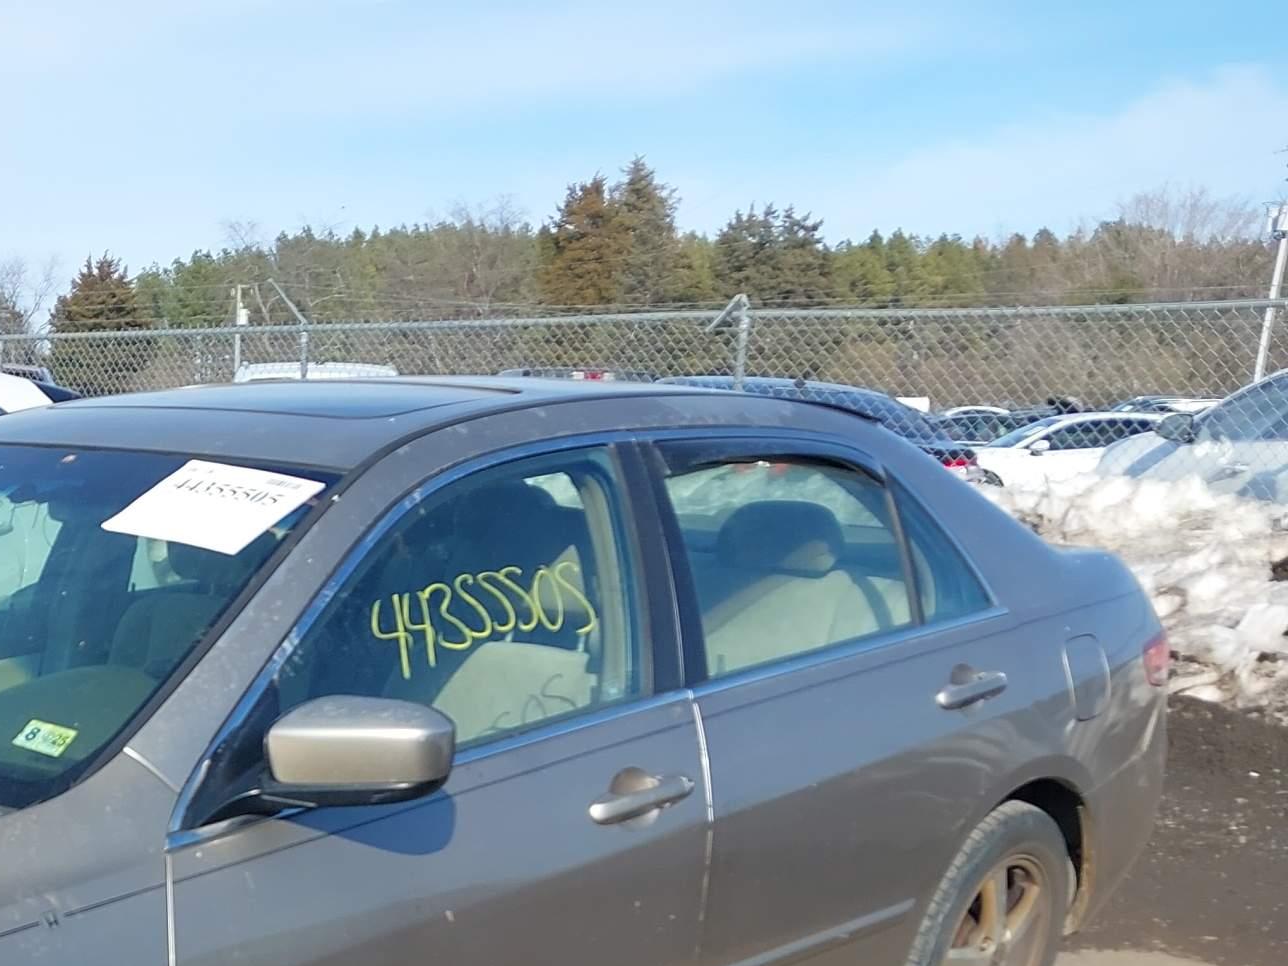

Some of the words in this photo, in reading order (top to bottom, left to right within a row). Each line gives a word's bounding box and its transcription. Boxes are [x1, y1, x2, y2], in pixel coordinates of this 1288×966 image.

[173, 477, 285, 505] 44355505
[371, 561, 596, 680] 44355505
[25, 727, 41, 741] 8
